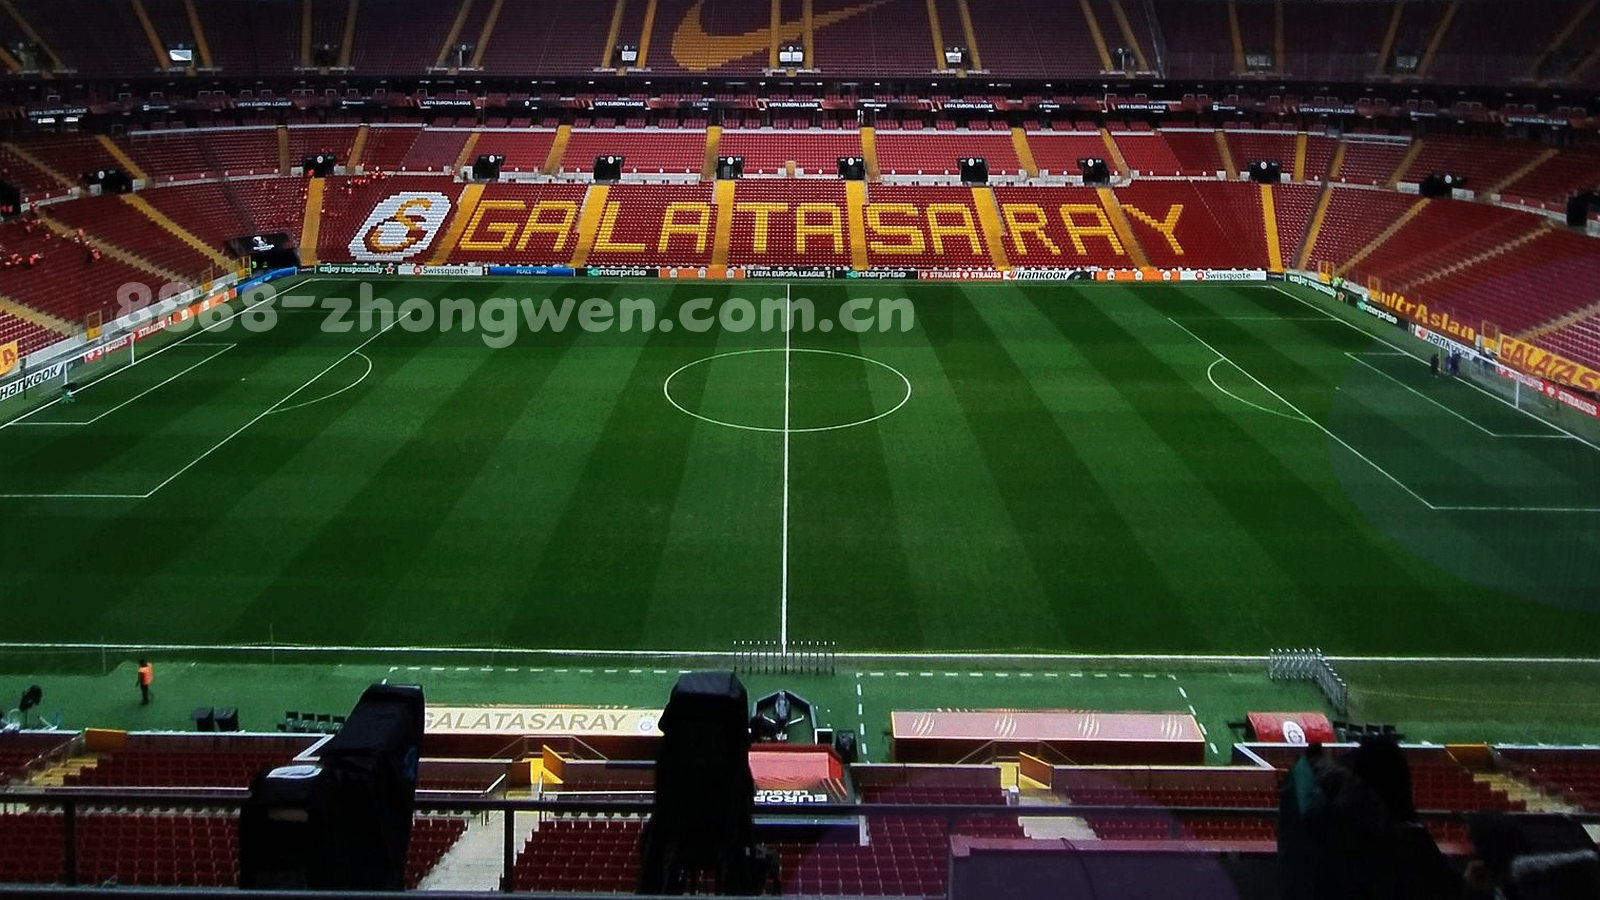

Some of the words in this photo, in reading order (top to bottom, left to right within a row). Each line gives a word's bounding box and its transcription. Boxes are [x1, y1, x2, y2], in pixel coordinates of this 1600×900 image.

[975, 102, 994, 110] LEAGUE
[1148, 103, 1167, 111] LEAGUE
[456, 199, 1185, 256] GALATASARAY
[319, 265, 340, 275] enjoy
[341, 264, 384, 275] responsibly
[423, 266, 469, 276] Swissquote
[752, 269, 771, 278] UEFA
[771, 269, 798, 278] EUROPA
[798, 269, 825, 278] LEAGUE
[929, 271, 961, 279] STRAUSS
[970, 271, 1001, 279] STRAUSS
[1205, 271, 1251, 281] Swissquote
[753, 794, 828, 803] EUROP
